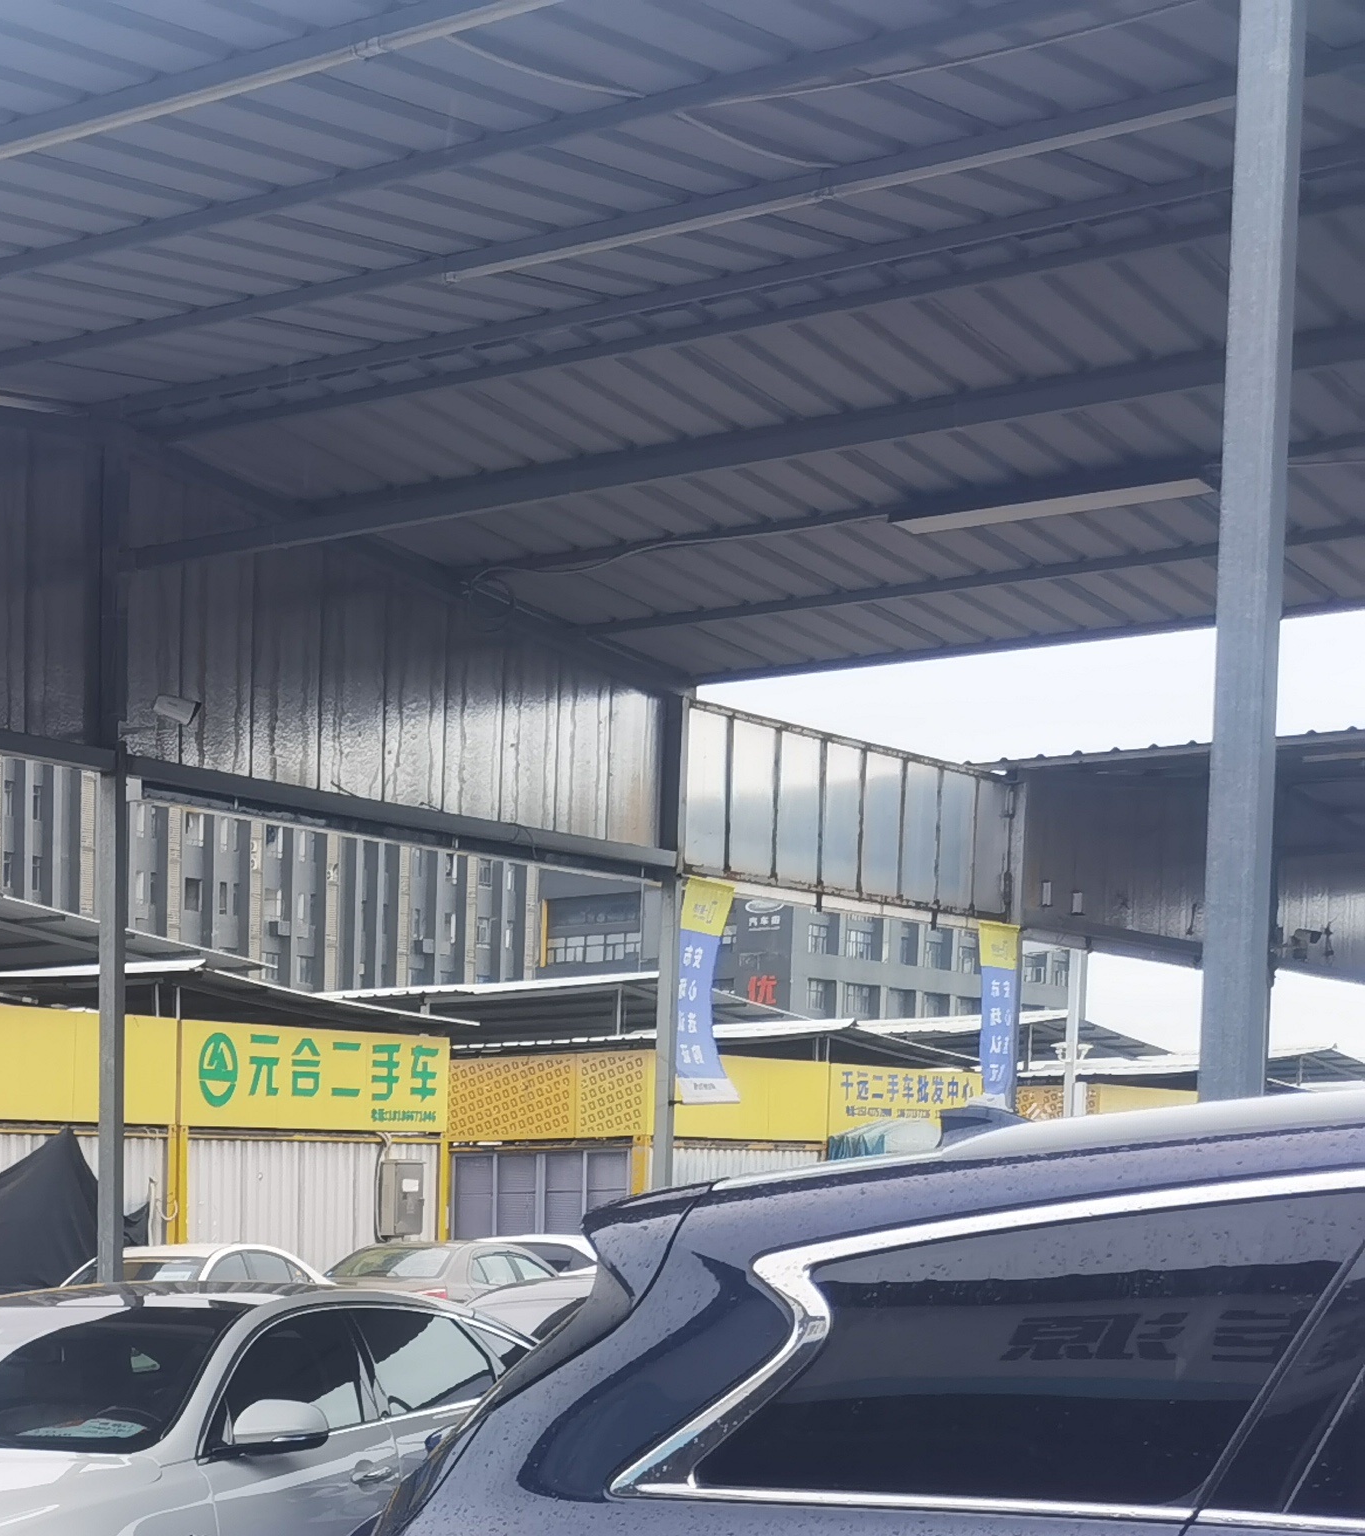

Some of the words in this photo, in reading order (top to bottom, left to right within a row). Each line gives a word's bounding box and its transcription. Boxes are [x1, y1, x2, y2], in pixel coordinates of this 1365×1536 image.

[747, 974, 777, 1005] 优
[247, 1033, 440, 1103] 元合二手车
